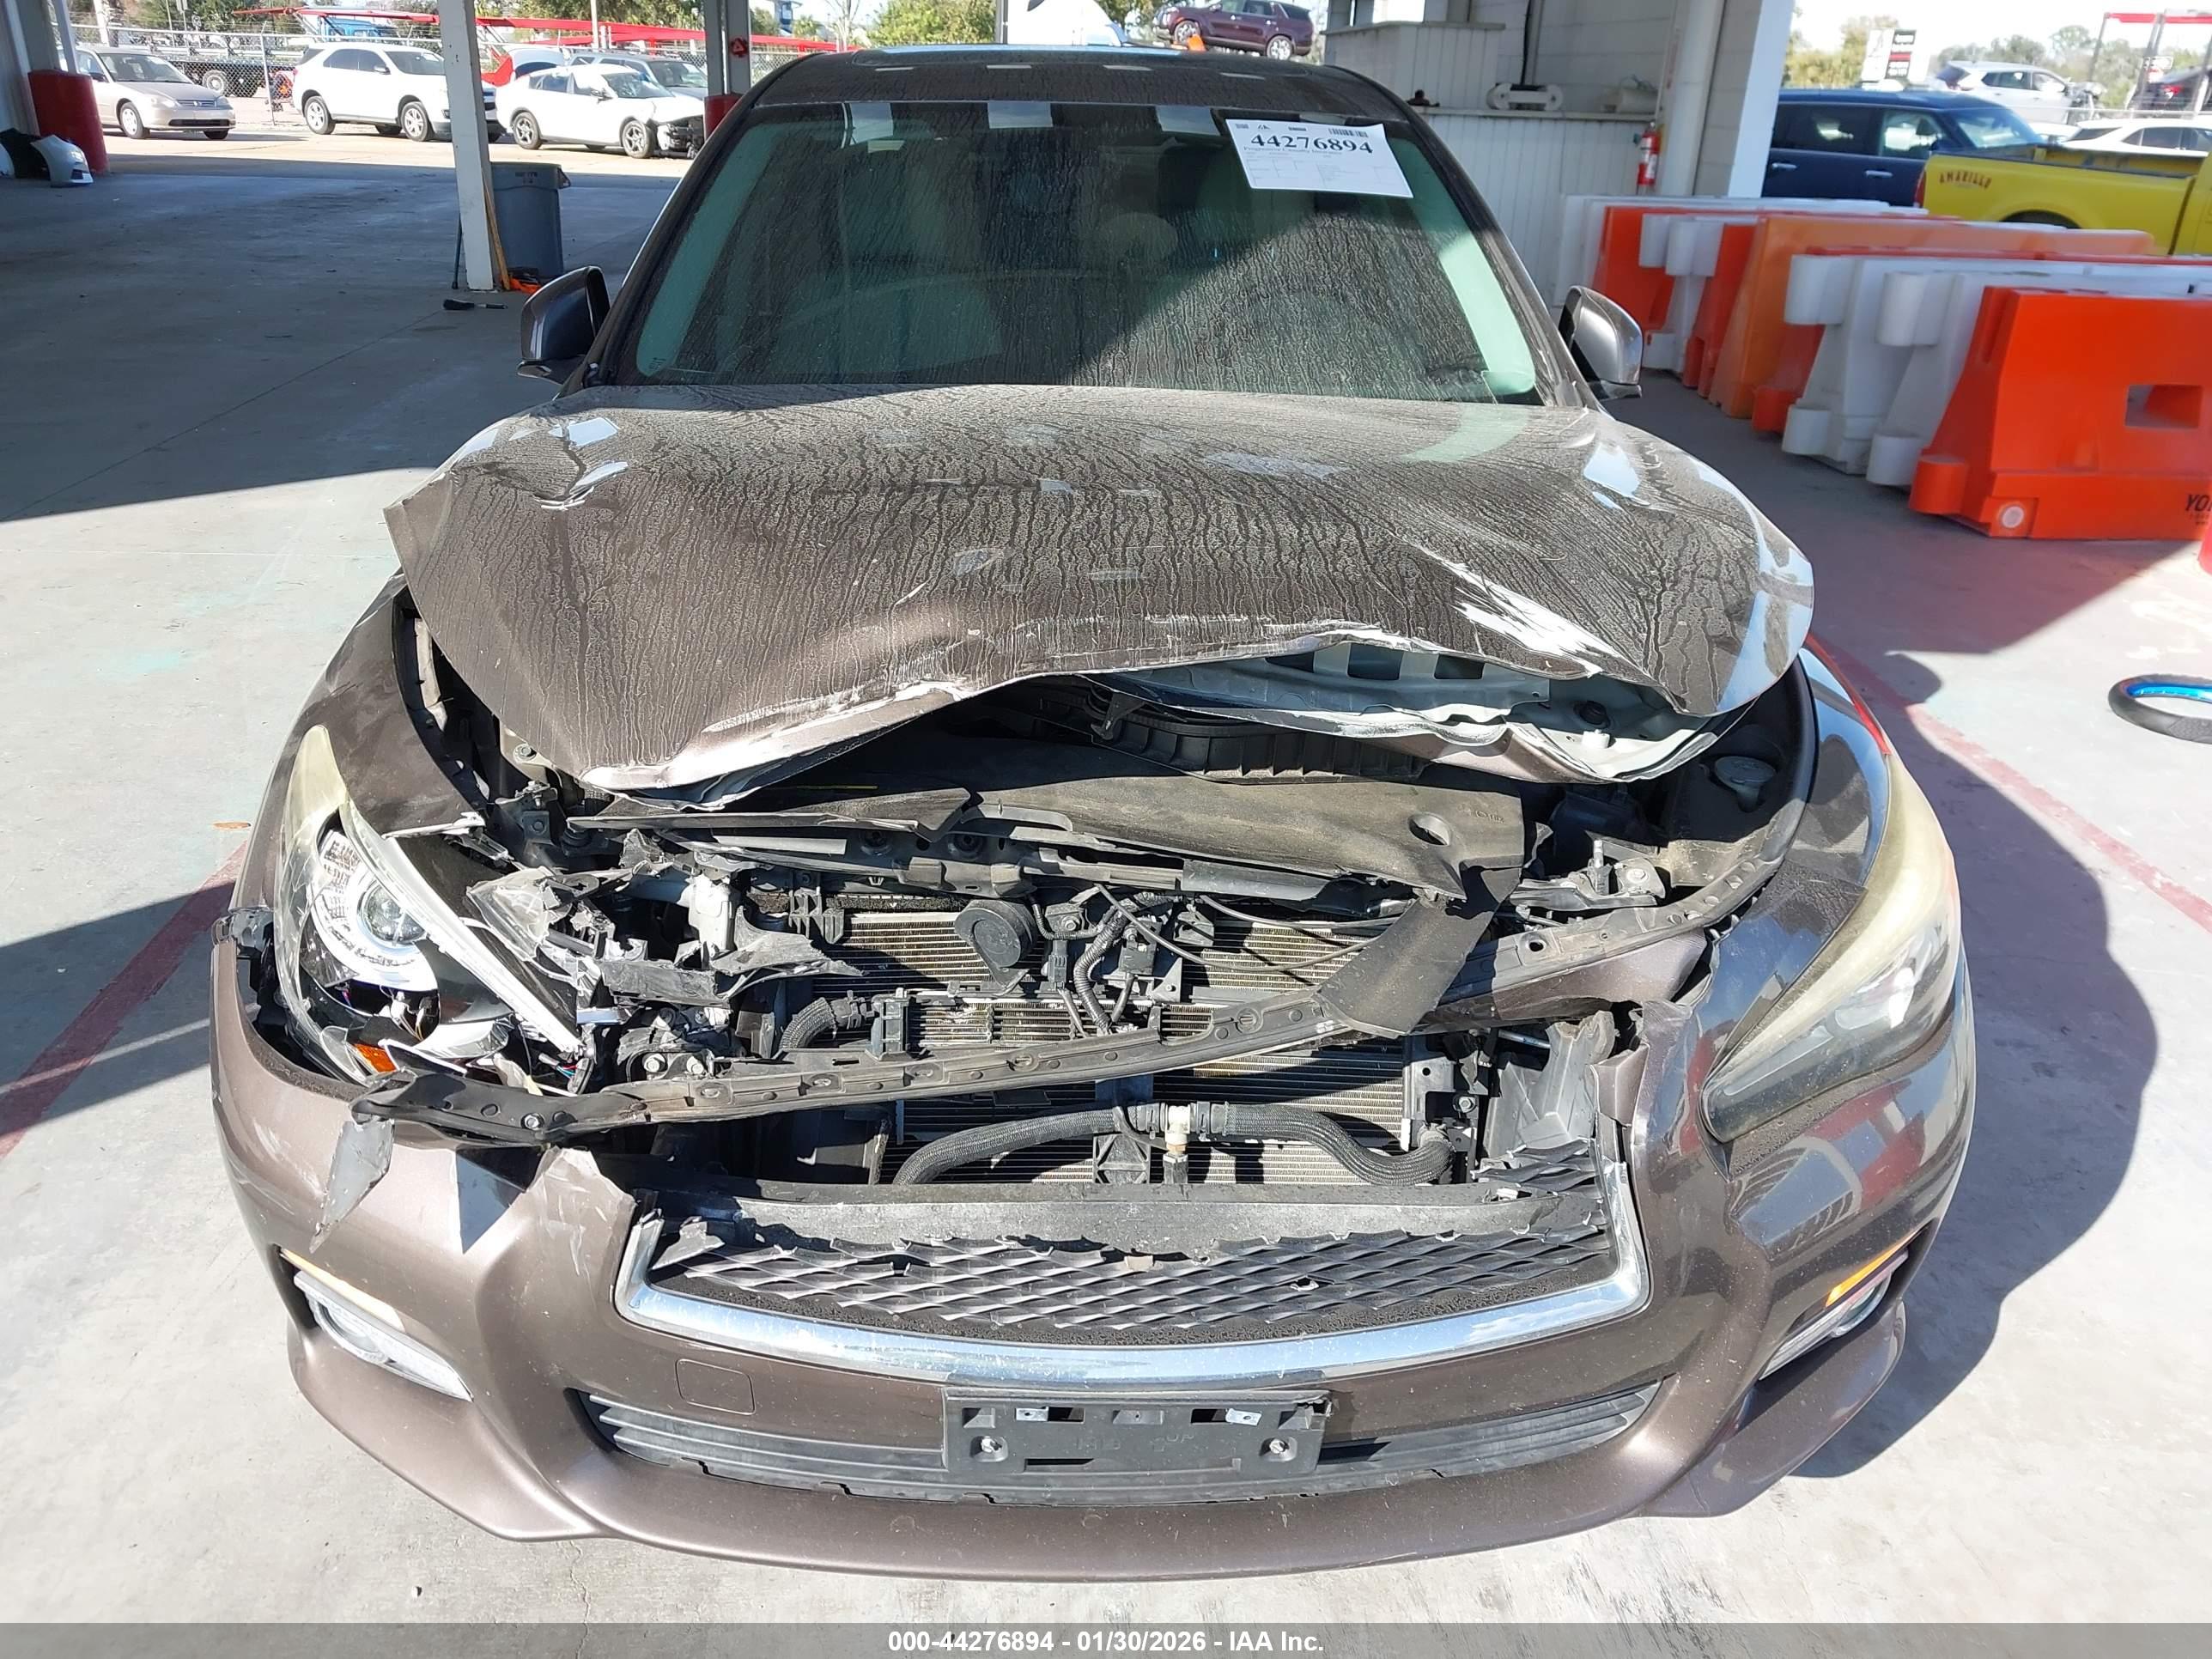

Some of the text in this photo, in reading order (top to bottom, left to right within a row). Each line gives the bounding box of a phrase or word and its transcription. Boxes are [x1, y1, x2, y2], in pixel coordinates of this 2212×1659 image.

[1250, 134, 1373, 154] 44276894
[1939, 170, 1992, 188] AMARILLO
[2185, 494, 2212, 511] YO
